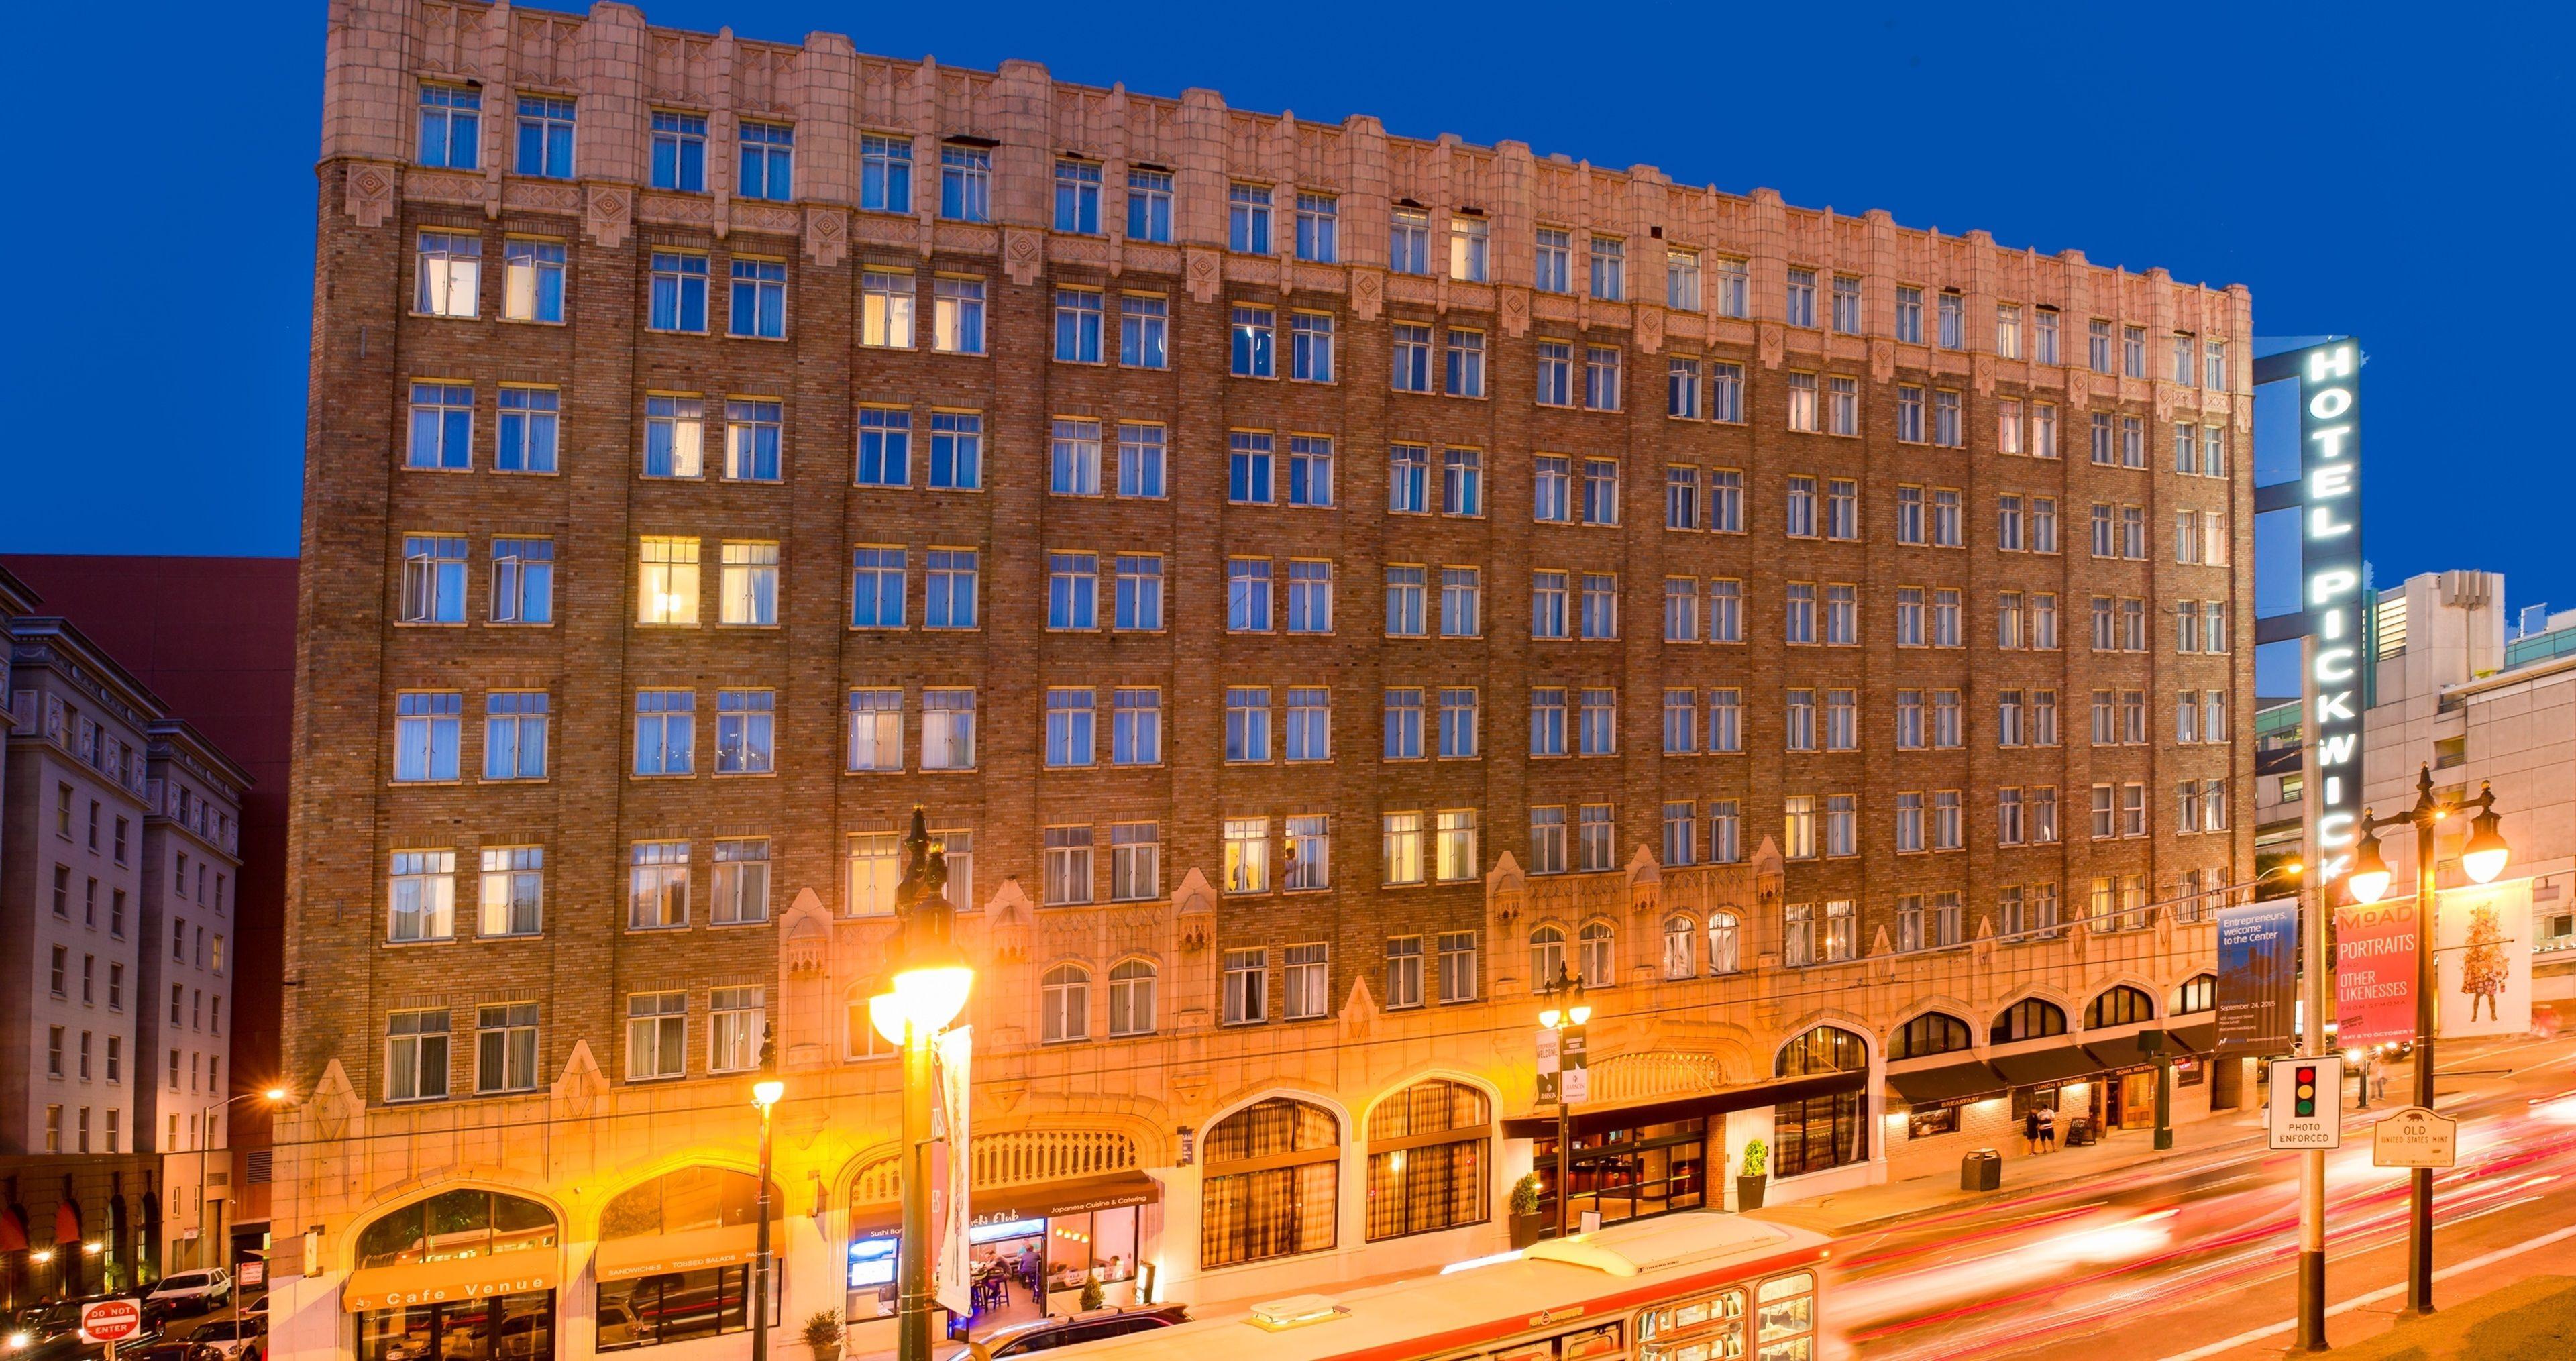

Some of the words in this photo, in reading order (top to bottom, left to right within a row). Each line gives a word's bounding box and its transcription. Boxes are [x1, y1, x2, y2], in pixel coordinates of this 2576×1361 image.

[2310, 347, 2351, 537] HOTEL
[2313, 571, 2356, 885] PICKWICK
[2224, 912, 2287, 927] Entrepreneurs,
[2224, 924, 2261, 936] welcome
[2224, 937, 2233, 945] to
[2233, 936, 2247, 944] the
[2249, 931, 2278, 942] Center
[2339, 933, 2414, 960] PORTRAITS
[2340, 970, 2375, 988] OTHER
[2340, 981, 2407, 1002] LIKENESSES
[2220, 1003, 2249, 1012] September
[2373, 1029, 2408, 1038] OCTOBER
[2033, 1083, 2055, 1091] LUNCH
[2063, 1077, 2087, 1085] DINNER
[1941, 1096, 1980, 1107] BREAKFAST
[2288, 1123, 2320, 1131] PHOTO
[2404, 1126, 2426, 1135] OLD
[2279, 1134, 2329, 1142] ENFORCED
[1051, 1204, 1085, 1214] Japanese
[1085, 1199, 1109, 1209] Cuisine
[1118, 1195, 1146, 1205] Catering
[993, 1208, 1019, 1223] Club
[871, 1229, 889, 1237] Sushi
[608, 1264, 662, 1276] SANDWICHES
[672, 1259, 704, 1268] TOSSED
[705, 1254, 736, 1264] SALADS
[386, 1289, 445, 1305] Cafe
[465, 1278, 543, 1297] Venue
[91, 1310, 105, 1318] DO
[111, 1307, 131, 1315] NOT
[95, 1324, 127, 1335] ENTER
